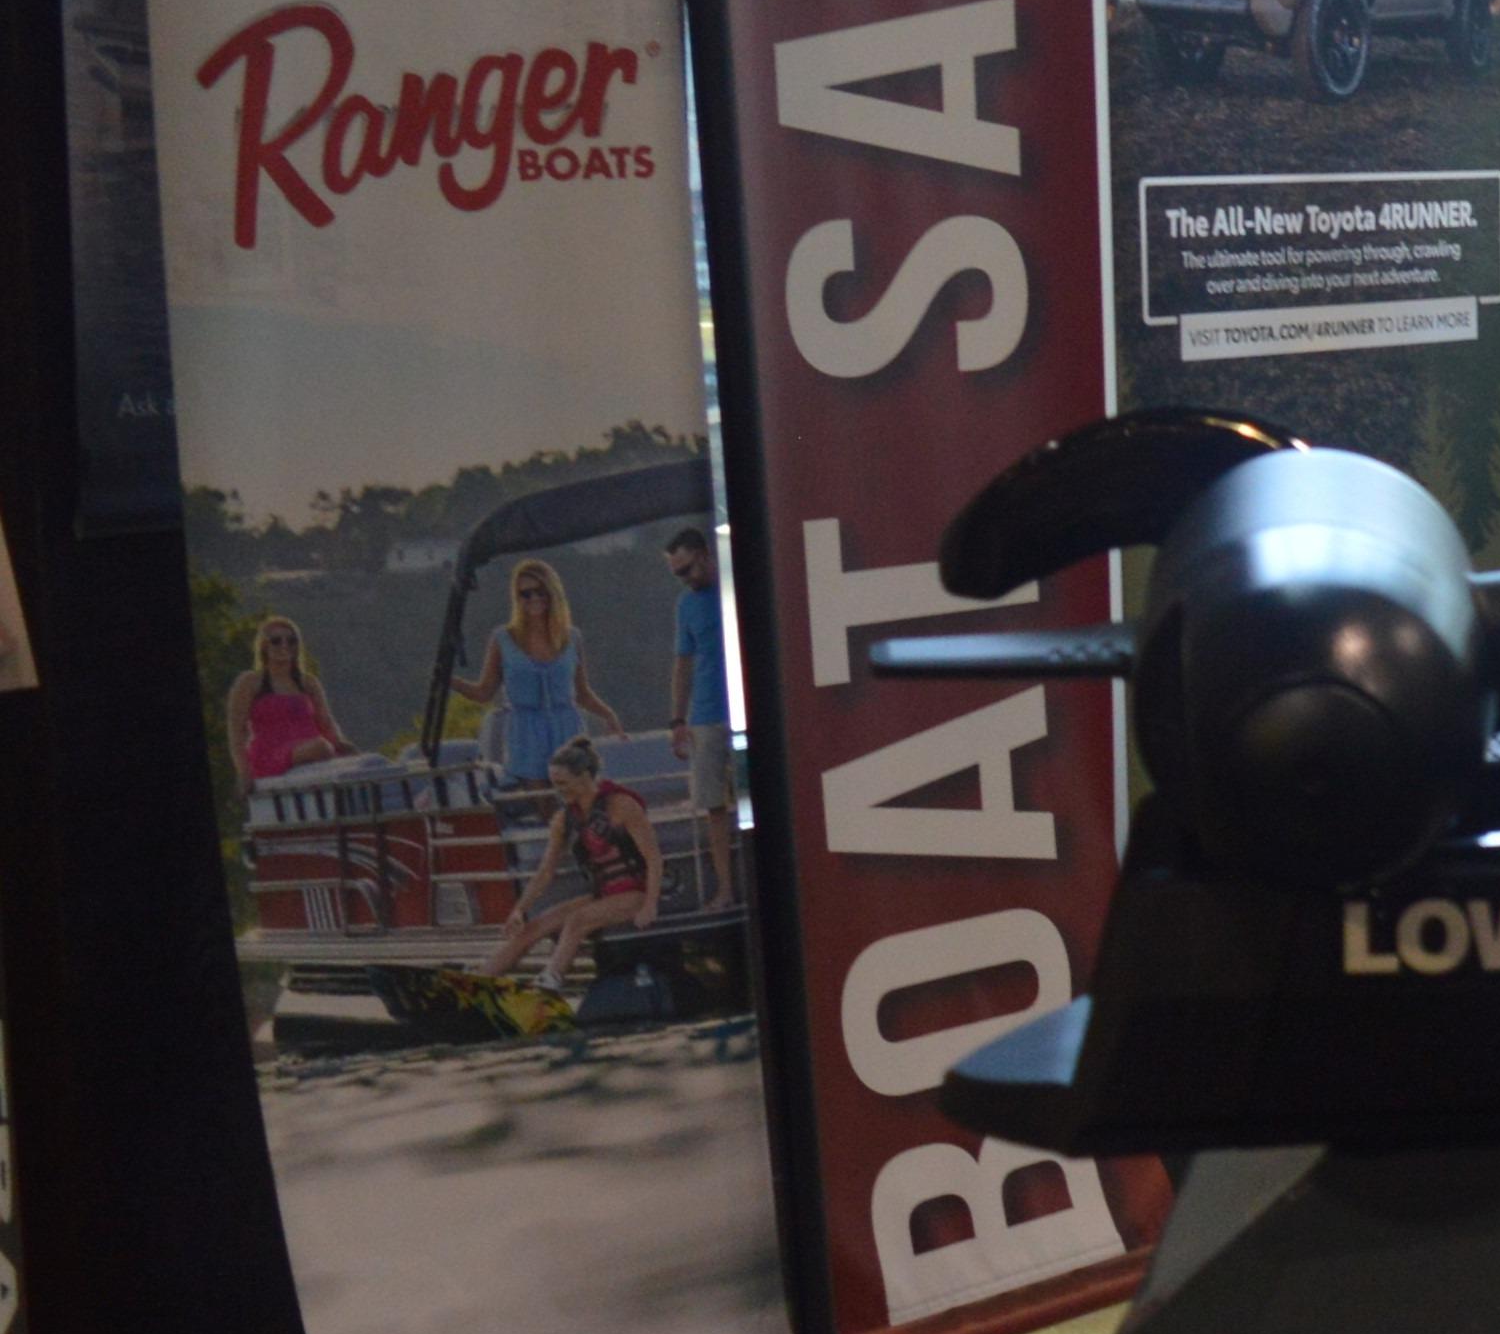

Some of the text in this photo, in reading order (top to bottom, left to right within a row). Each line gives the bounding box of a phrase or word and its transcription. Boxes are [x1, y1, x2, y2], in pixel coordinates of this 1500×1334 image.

[196, 1, 639, 250] Ranger
[517, 147, 655, 183] BOATS
[1166, 200, 1478, 240] The All-New Toyota 4RUNNER.
[1182, 251, 1206, 270] The
[1207, 248, 1260, 269] ultimate
[1261, 247, 1286, 265] tool
[1287, 246, 1304, 264] for
[1305, 245, 1362, 269] powering
[1413, 240, 1461, 262] crawling
[1206, 278, 1235, 294] over
[1236, 274, 1261, 292] and
[1325, 272, 1353, 292] your
[1189, 311, 1471, 348] VISIT TOYOTA.COM/4RUNNER TO LEARN MORE
[802, 517, 1125, 1327] BOAT
